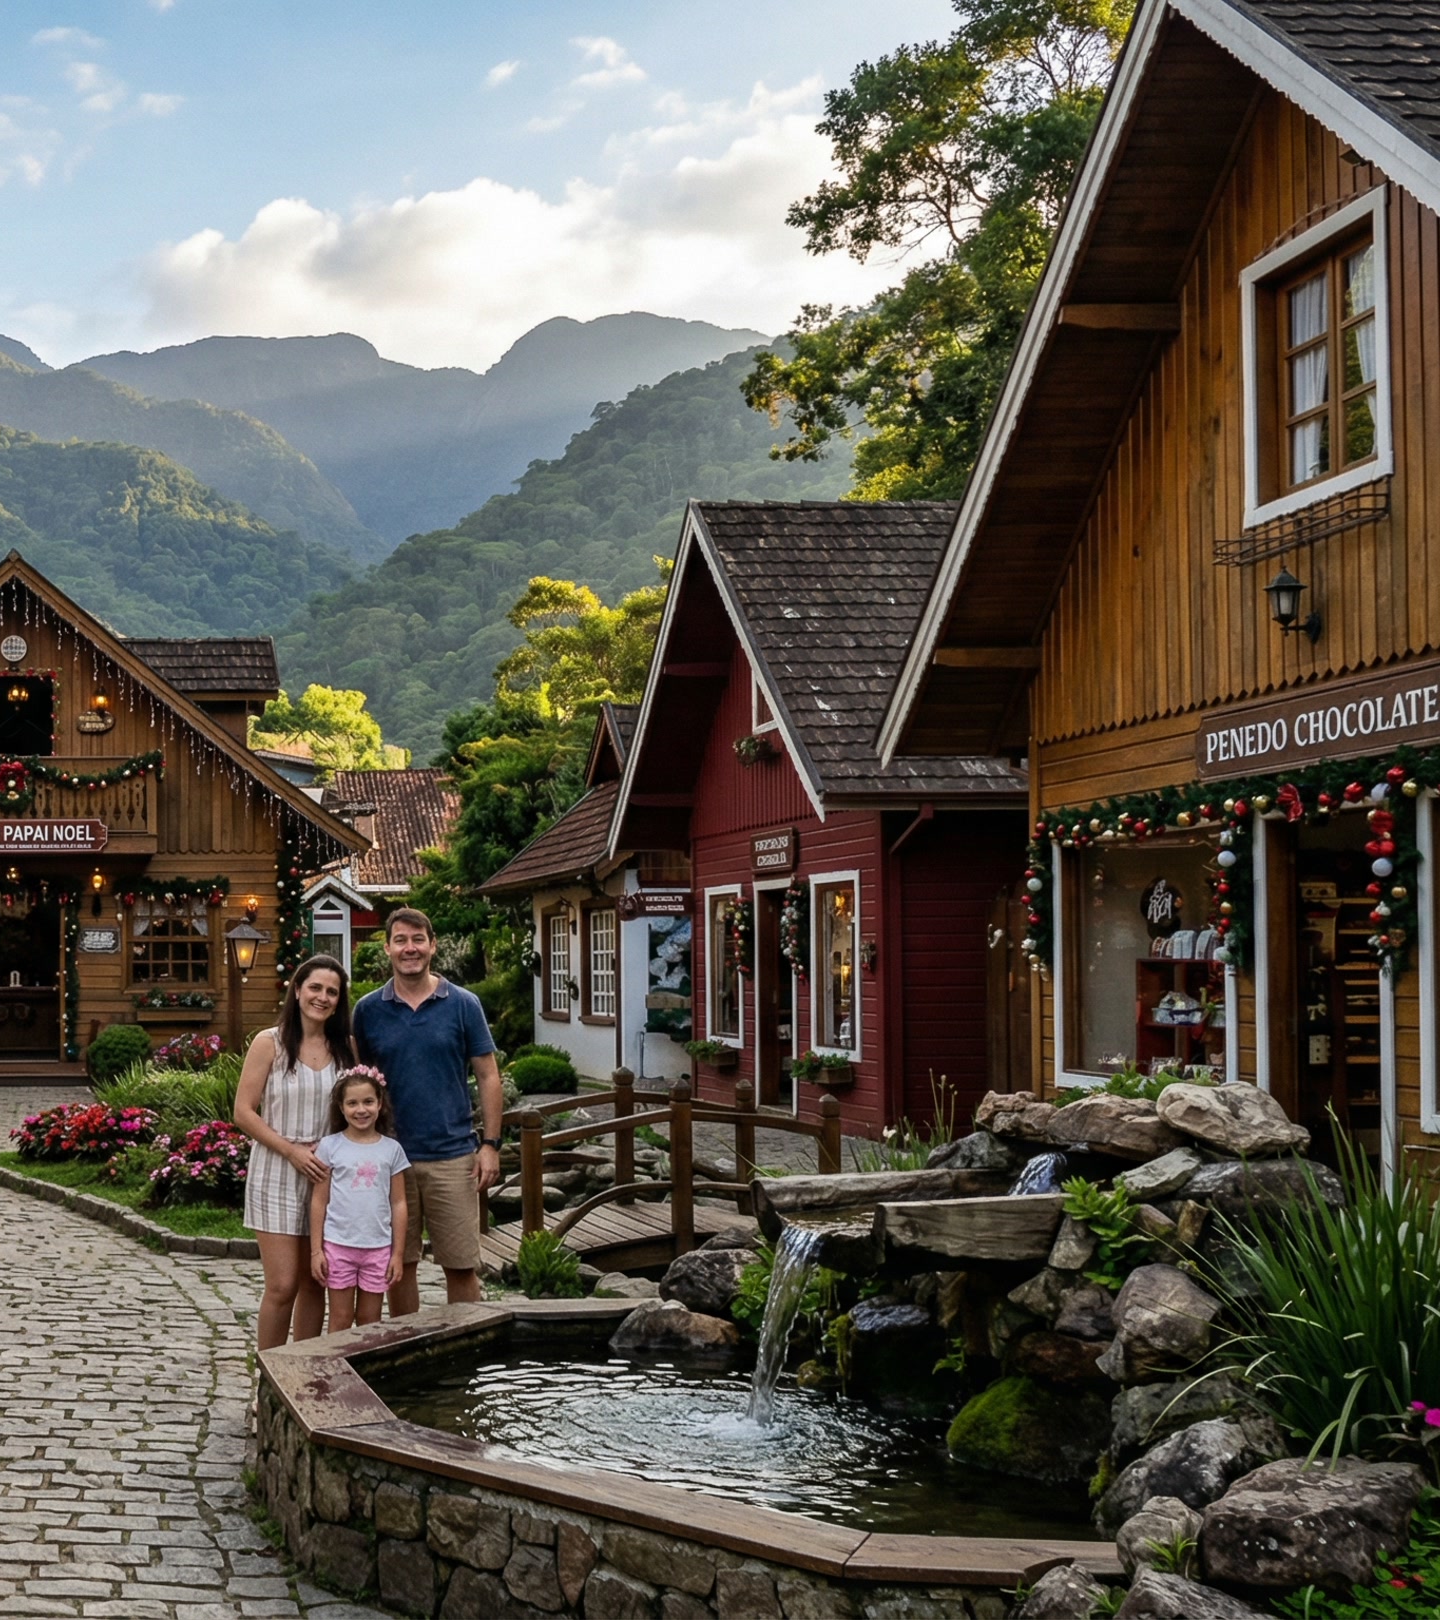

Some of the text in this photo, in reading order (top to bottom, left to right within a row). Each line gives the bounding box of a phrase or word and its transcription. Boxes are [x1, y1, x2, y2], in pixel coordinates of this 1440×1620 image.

[1205, 684, 1439, 764] PENEDO CHOCOLATE
[4, 825, 49, 842] PAPAI
[53, 825, 96, 842] NOEL
